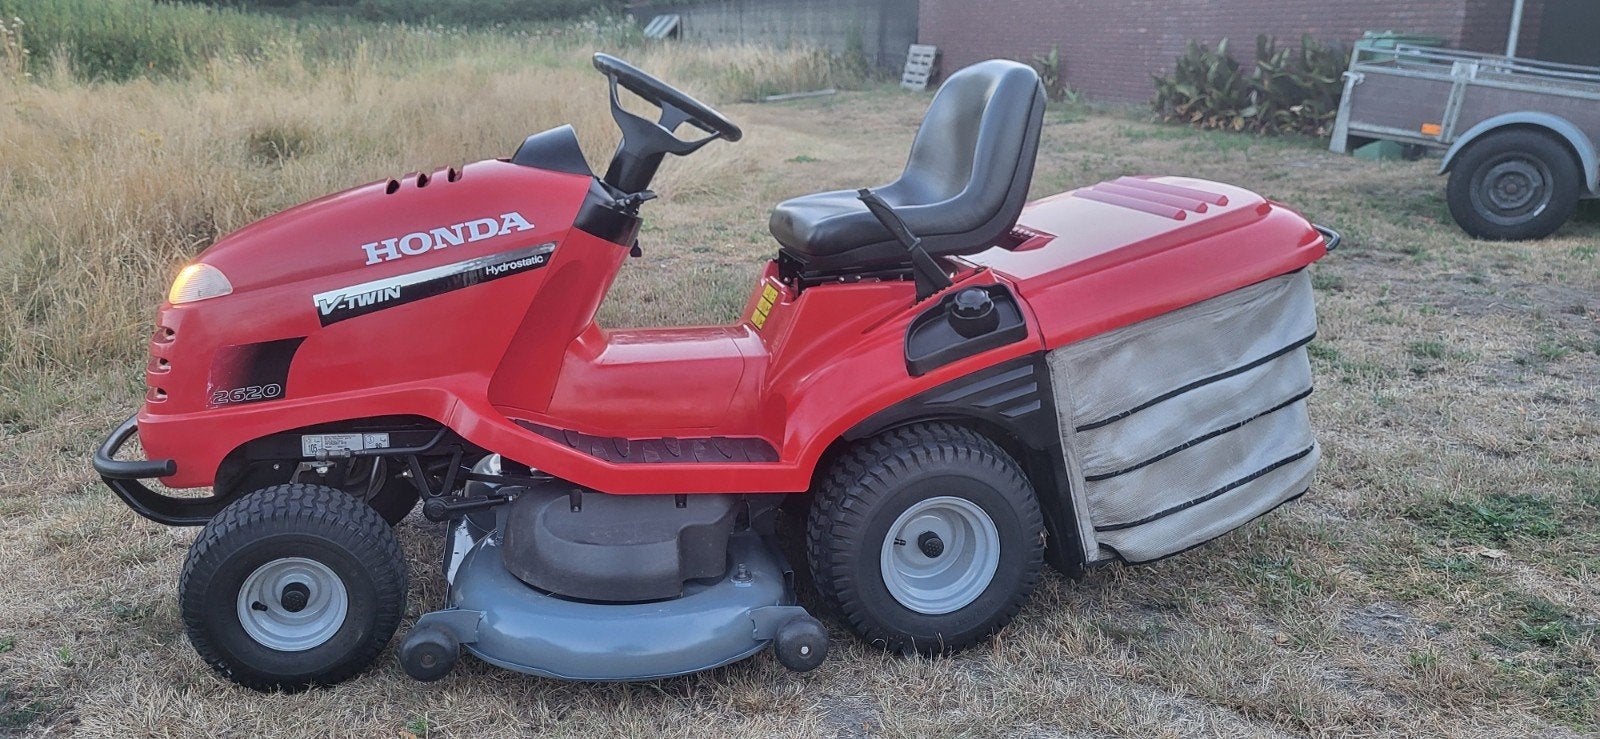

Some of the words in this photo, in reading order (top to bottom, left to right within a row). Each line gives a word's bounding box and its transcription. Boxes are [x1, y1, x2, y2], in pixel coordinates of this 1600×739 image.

[362, 212, 535, 266] HONDA
[485, 254, 544, 276] Hydrostatic
[317, 285, 401, 316] V-TWIN
[212, 383, 282, 405] 2620
